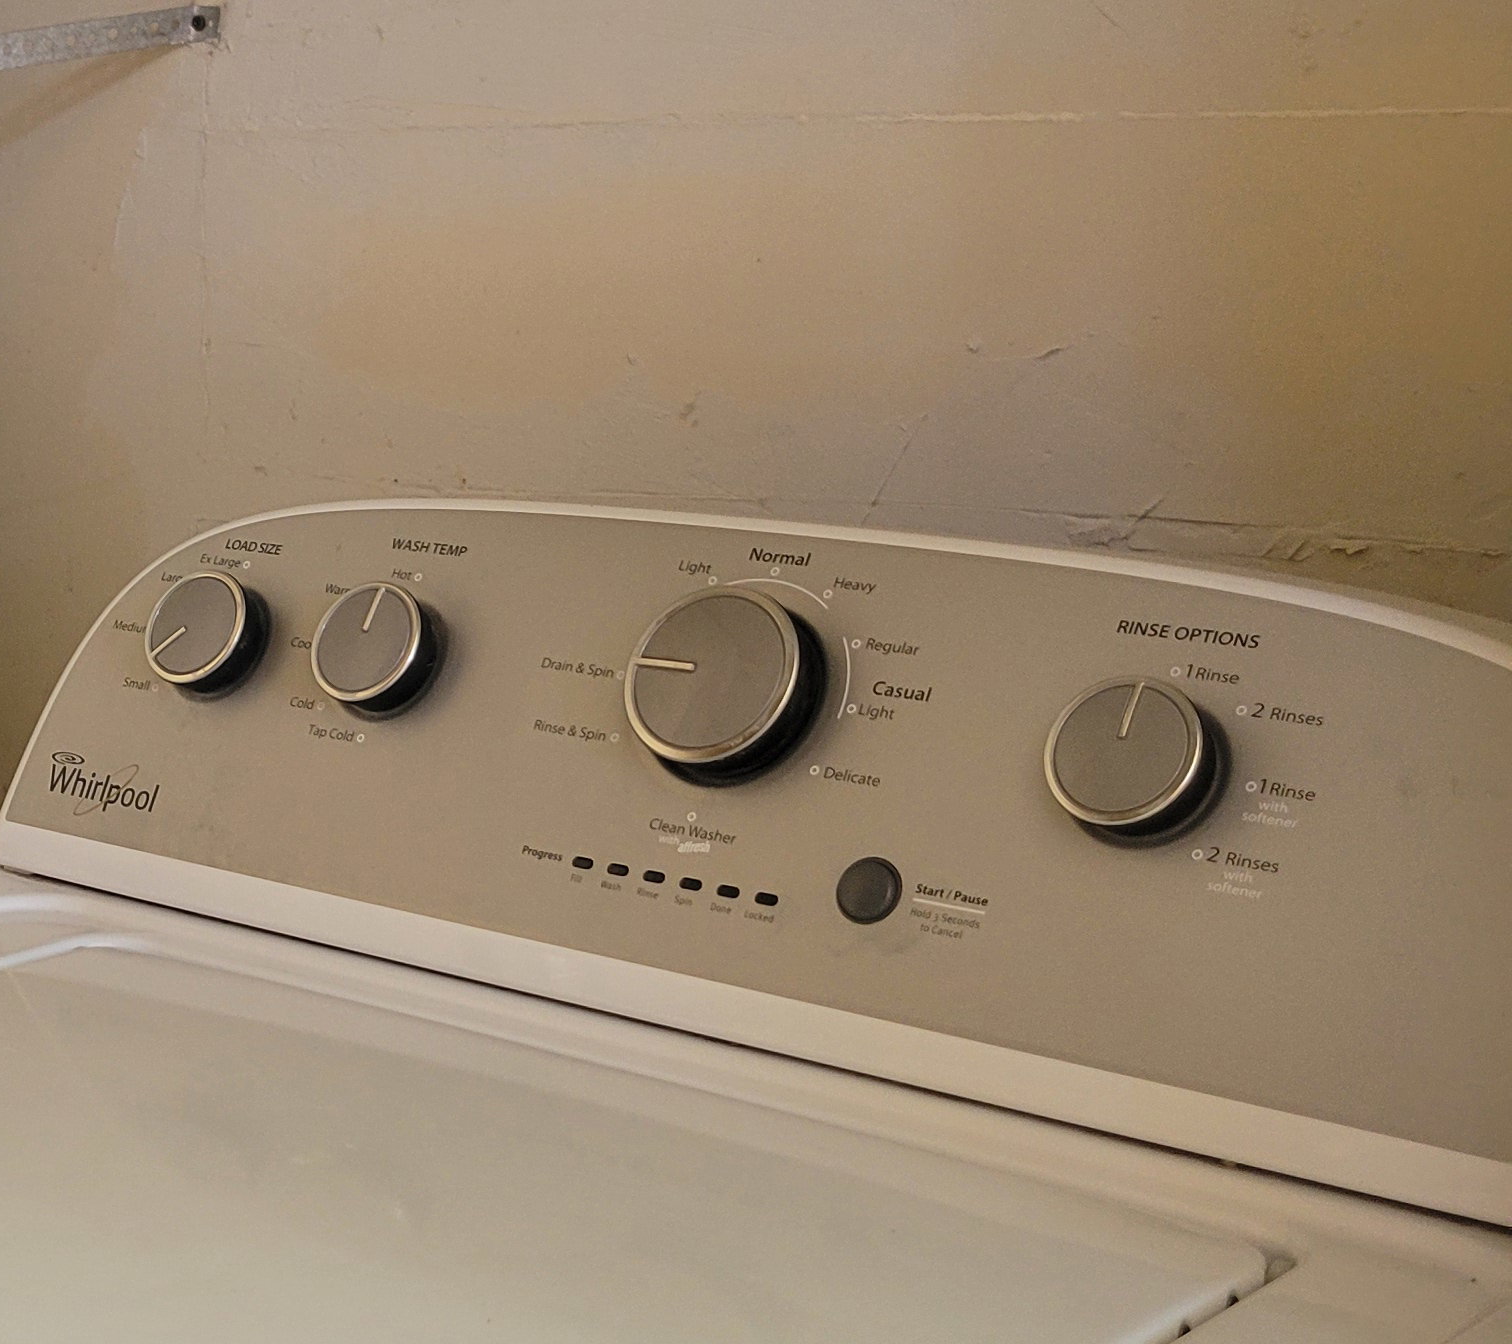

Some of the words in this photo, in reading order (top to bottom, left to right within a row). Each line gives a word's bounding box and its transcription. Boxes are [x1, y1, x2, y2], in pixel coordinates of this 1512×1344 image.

[225, 538, 257, 554] LOAD
[258, 542, 283, 556] SIZE
[392, 537, 430, 554] WASH
[432, 542, 468, 557] TEMP
[199, 553, 211, 564] Ex
[213, 555, 241, 570] Large
[748, 547, 812, 568] Normal
[391, 568, 413, 581] Hot
[678, 560, 712, 575] Light
[325, 583, 351, 596] War
[833, 576, 878, 596] Heavy
[112, 619, 147, 635] Mediu
[1116, 619, 1171, 639] RINSE
[1174, 626, 1261, 649] OPTIONS
[290, 636, 312, 650] Coo
[865, 637, 920, 656] Regular
[540, 657, 573, 671] Drain
[575, 662, 586, 674] &
[588, 663, 615, 679] Spin
[1195, 666, 1240, 685] Rinse
[122, 676, 151, 691] Small
[872, 680, 933, 703] Casual
[289, 696, 315, 710] Cold
[857, 703, 896, 722] Light
[1250, 702, 1266, 719] 2
[1269, 706, 1324, 727] Rinses
[308, 723, 328, 739] Tap
[329, 727, 355, 742] Cold
[533, 719, 566, 736] Rinse
[567, 725, 578, 737] &
[579, 726, 607, 742] Spin
[823, 765, 881, 788] Delicate
[49, 763, 160, 813] Whirlpool
[1269, 782, 1317, 802] Rinse
[1258, 800, 1289, 814] with
[1241, 811, 1299, 829] softener
[648, 817, 686, 836] Clean
[688, 824, 737, 846] Washer
[521, 844, 564, 863] Progress
[1205, 846, 1220, 863] 2
[1224, 851, 1280, 873] Rinses
[600, 880, 622, 893] Wash
[1223, 871, 1253, 883] with
[637, 887, 660, 900] Rinse
[915, 883, 945, 899] Start
[946, 889, 954, 900] /
[953, 890, 989, 906] Pause
[1207, 881, 1263, 899] softener
[674, 894, 694, 907] Spin
[709, 902, 733, 915] Done
[743, 909, 775, 924] Locked
[909, 907, 932, 920] Hold
[941, 912, 981, 929] Seconds
[919, 923, 930, 933] to
[931, 925, 964, 940] Cancel
